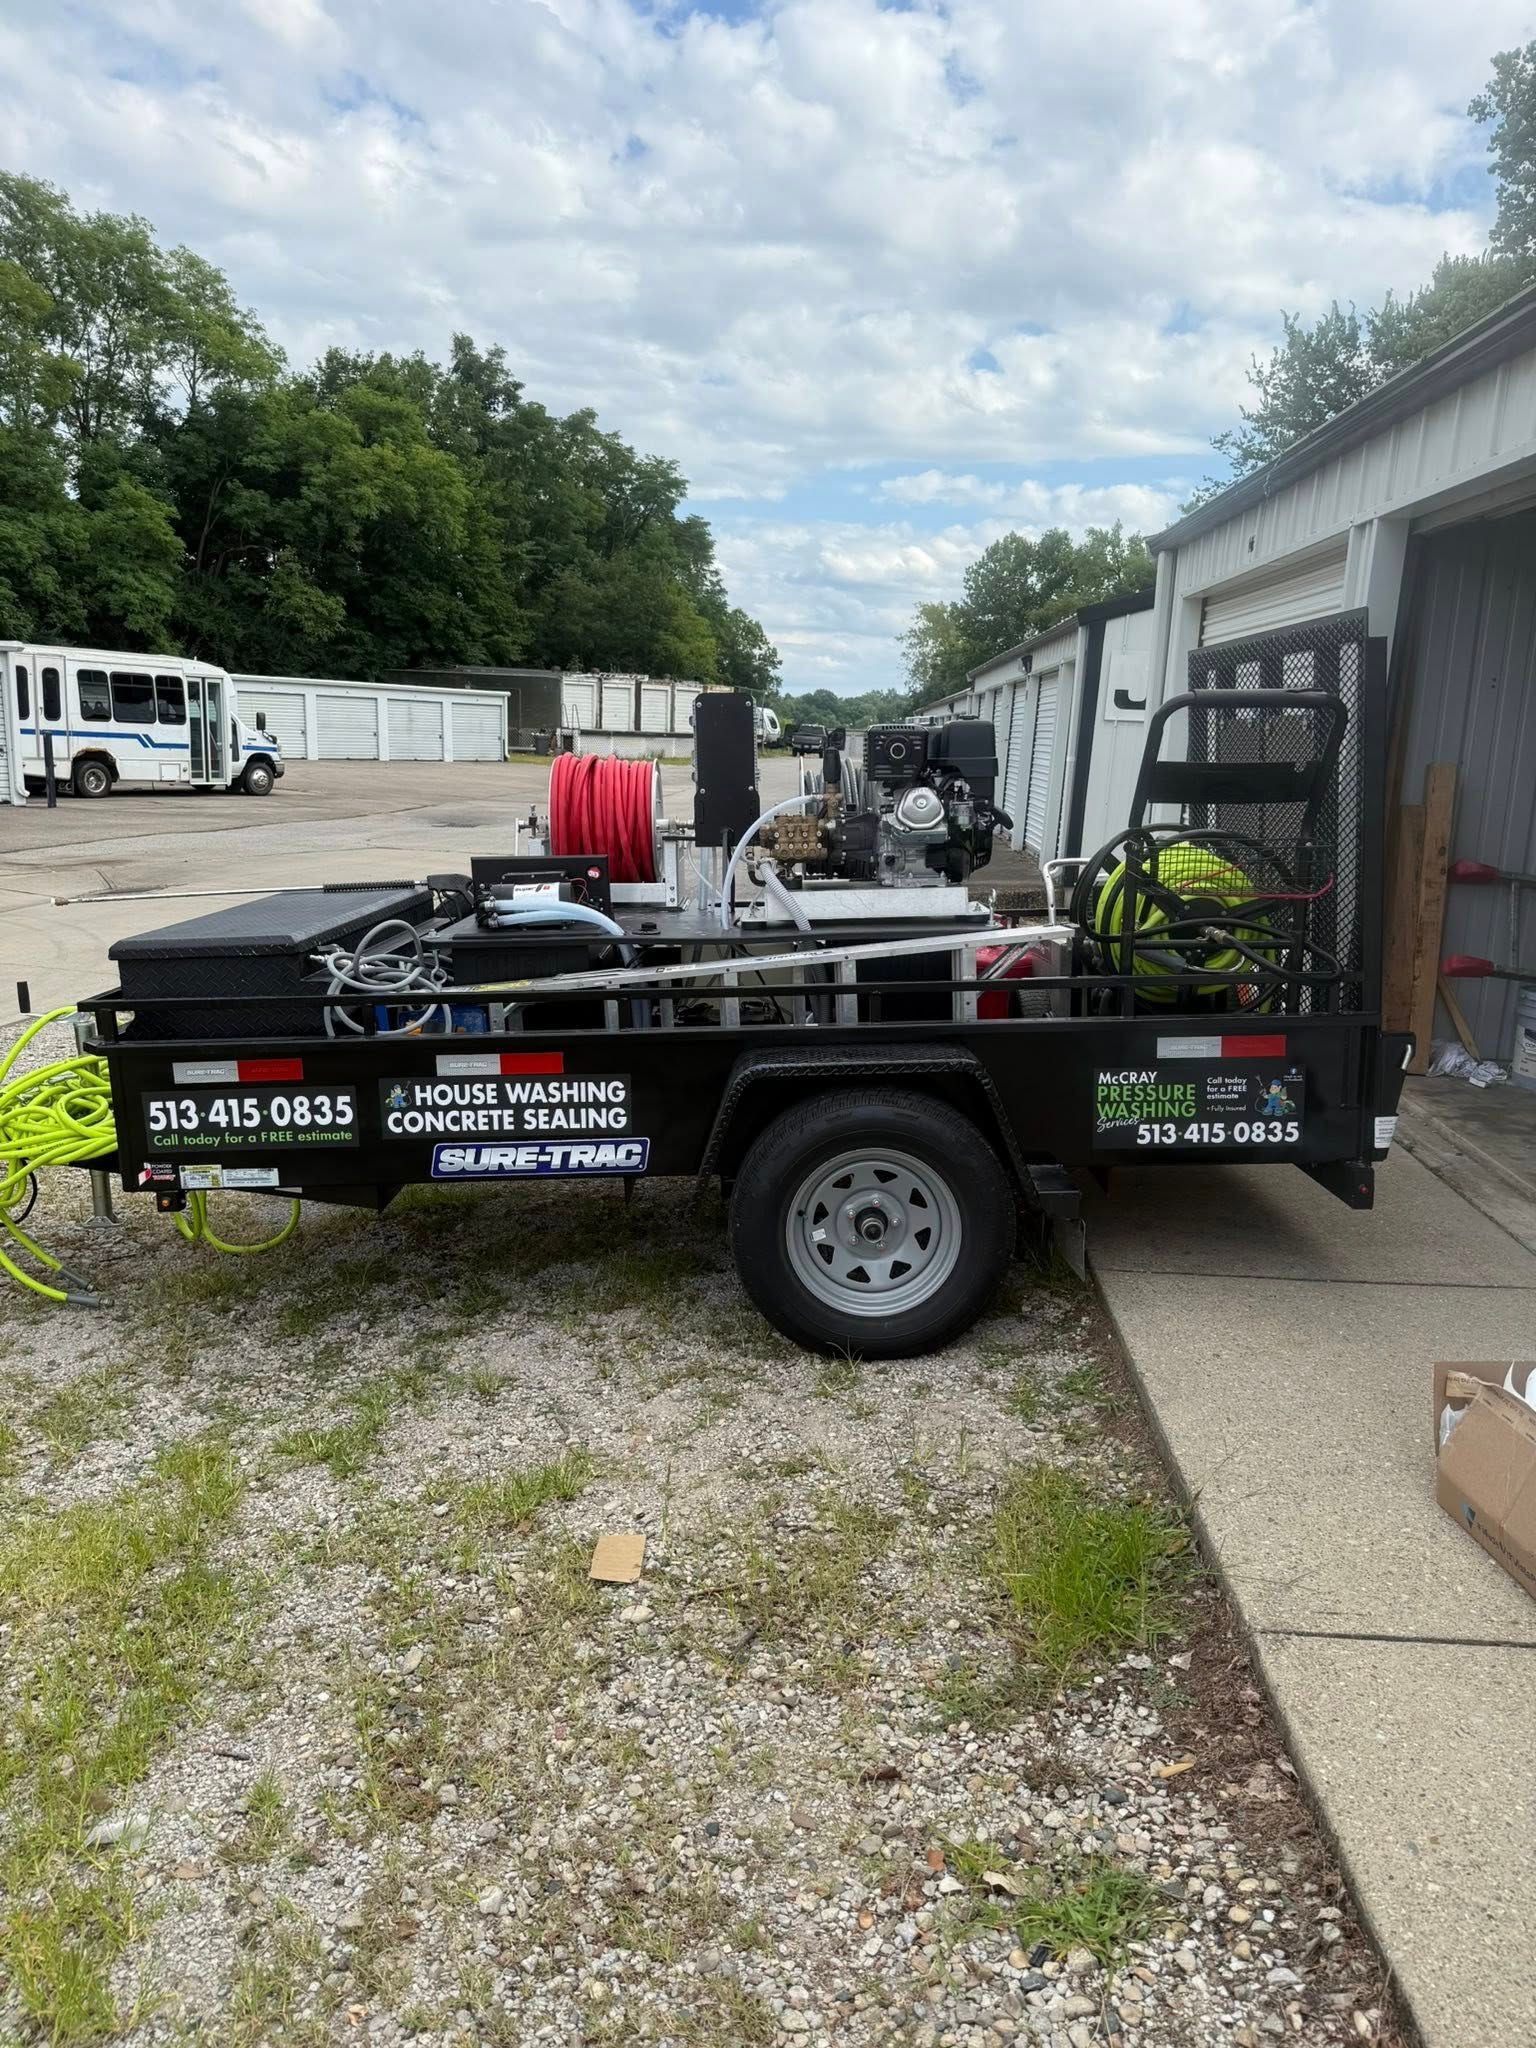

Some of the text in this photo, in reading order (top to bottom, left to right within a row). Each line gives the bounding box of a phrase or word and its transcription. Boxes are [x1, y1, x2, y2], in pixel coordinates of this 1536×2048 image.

[1098, 1071, 1158, 1085] McCRAY
[1206, 1076, 1248, 1085] Call today
[414, 1080, 626, 1107] HOUSE WASHING
[1097, 1084, 1196, 1101] PRESSURE
[1096, 1101, 1197, 1118] WASHING
[387, 1107, 628, 1134] CONCRETE SEALING
[153, 1129, 353, 1147] Call today for a FREE estimate
[438, 1143, 645, 1172] SURE-TRAC
